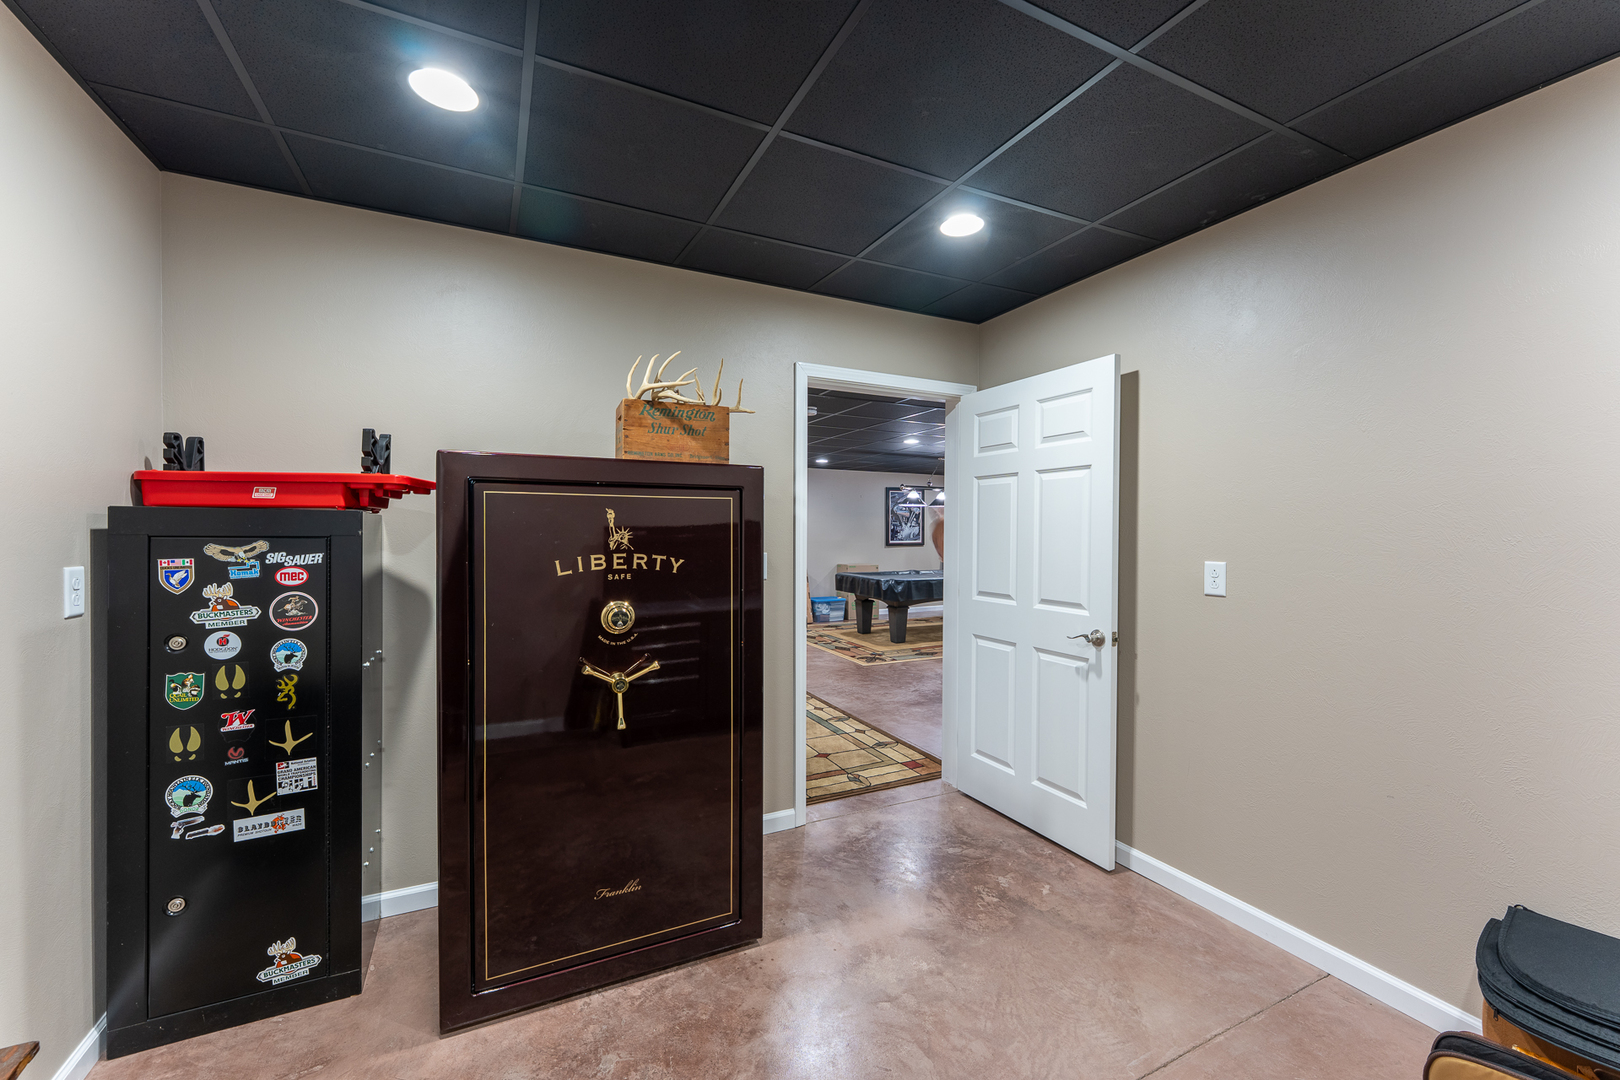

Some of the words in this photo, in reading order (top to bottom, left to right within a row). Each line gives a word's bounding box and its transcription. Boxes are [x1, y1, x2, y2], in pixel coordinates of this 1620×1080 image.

[639, 402, 716, 422] Remington
[647, 422, 679, 436] Shur
[680, 424, 707, 437] Shot
[265, 551, 287, 564] SIG
[284, 553, 322, 566] SAUER
[554, 552, 685, 577] LIBERTY
[197, 608, 254, 620] BUCKMASTERS
[276, 615, 313, 623] WINCHESTER
[207, 619, 246, 628] MEMBER
[293, 764, 317, 772] AMERICAN
[593, 877, 642, 900] Franklin
[263, 957, 316, 978] BUCKMASTERS
[273, 969, 308, 984] MEMBER
